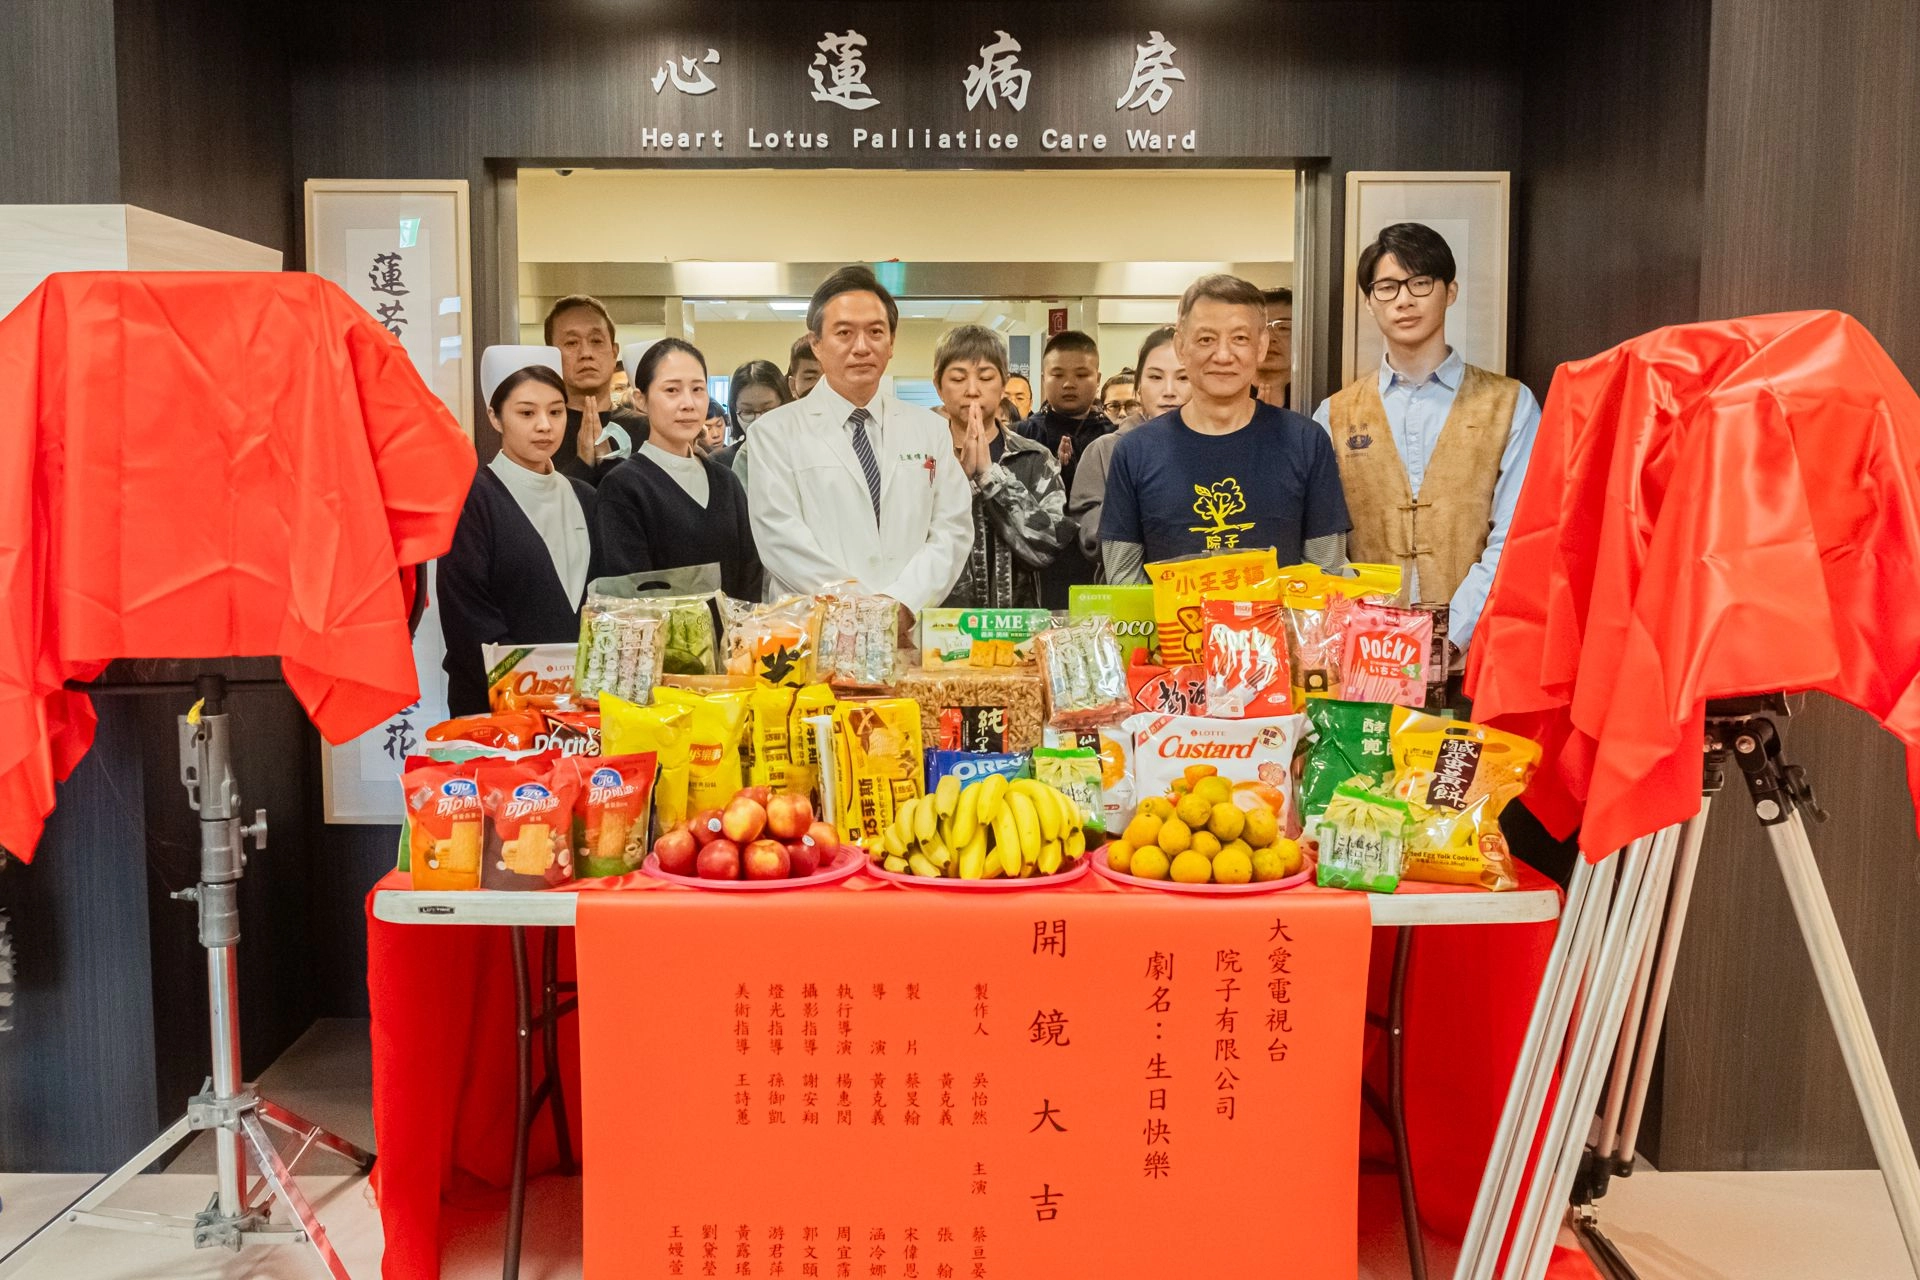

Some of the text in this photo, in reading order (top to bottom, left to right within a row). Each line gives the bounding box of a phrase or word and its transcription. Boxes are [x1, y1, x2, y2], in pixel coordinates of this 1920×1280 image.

[651, 30, 1187, 113] 心蓮病房
[641, 127, 1196, 151] Heart Lotus Palliatice Care Ward
[1206, 534, 1240, 549] 院子
[1114, 620, 1155, 636] oco
[513, 671, 575, 696] Cust
[1369, 665, 1400, 676] いちご
[534, 734, 600, 758] Dorito
[1158, 735, 1258, 760] Custard
[436, 796, 481, 816] 可口奶
[1452, 854, 1479, 862] Cookies
[973, 983, 990, 1036] 製作人
[1265, 917, 1294, 1063] 大愛電視台
[733, 982, 751, 1056] 美術指導
[767, 983, 786, 1056] 燈光指導
[801, 983, 819, 1056] 攝影指導
[836, 983, 854, 1056] 執行導演
[1214, 948, 1243, 1121] 院子有限公司
[1027, 919, 1071, 1223] 開鏡大吉
[767, 1072, 786, 1125] 孫御凱
[801, 1072, 819, 1126] 謝安翔
[870, 1072, 887, 1126] 黃克義
[938, 1072, 955, 1126] 黃克義
[971, 1072, 989, 1126] 吳怡然
[971, 1161, 988, 1195] 主演
[903, 1226, 920, 1279] 宋偉恩
